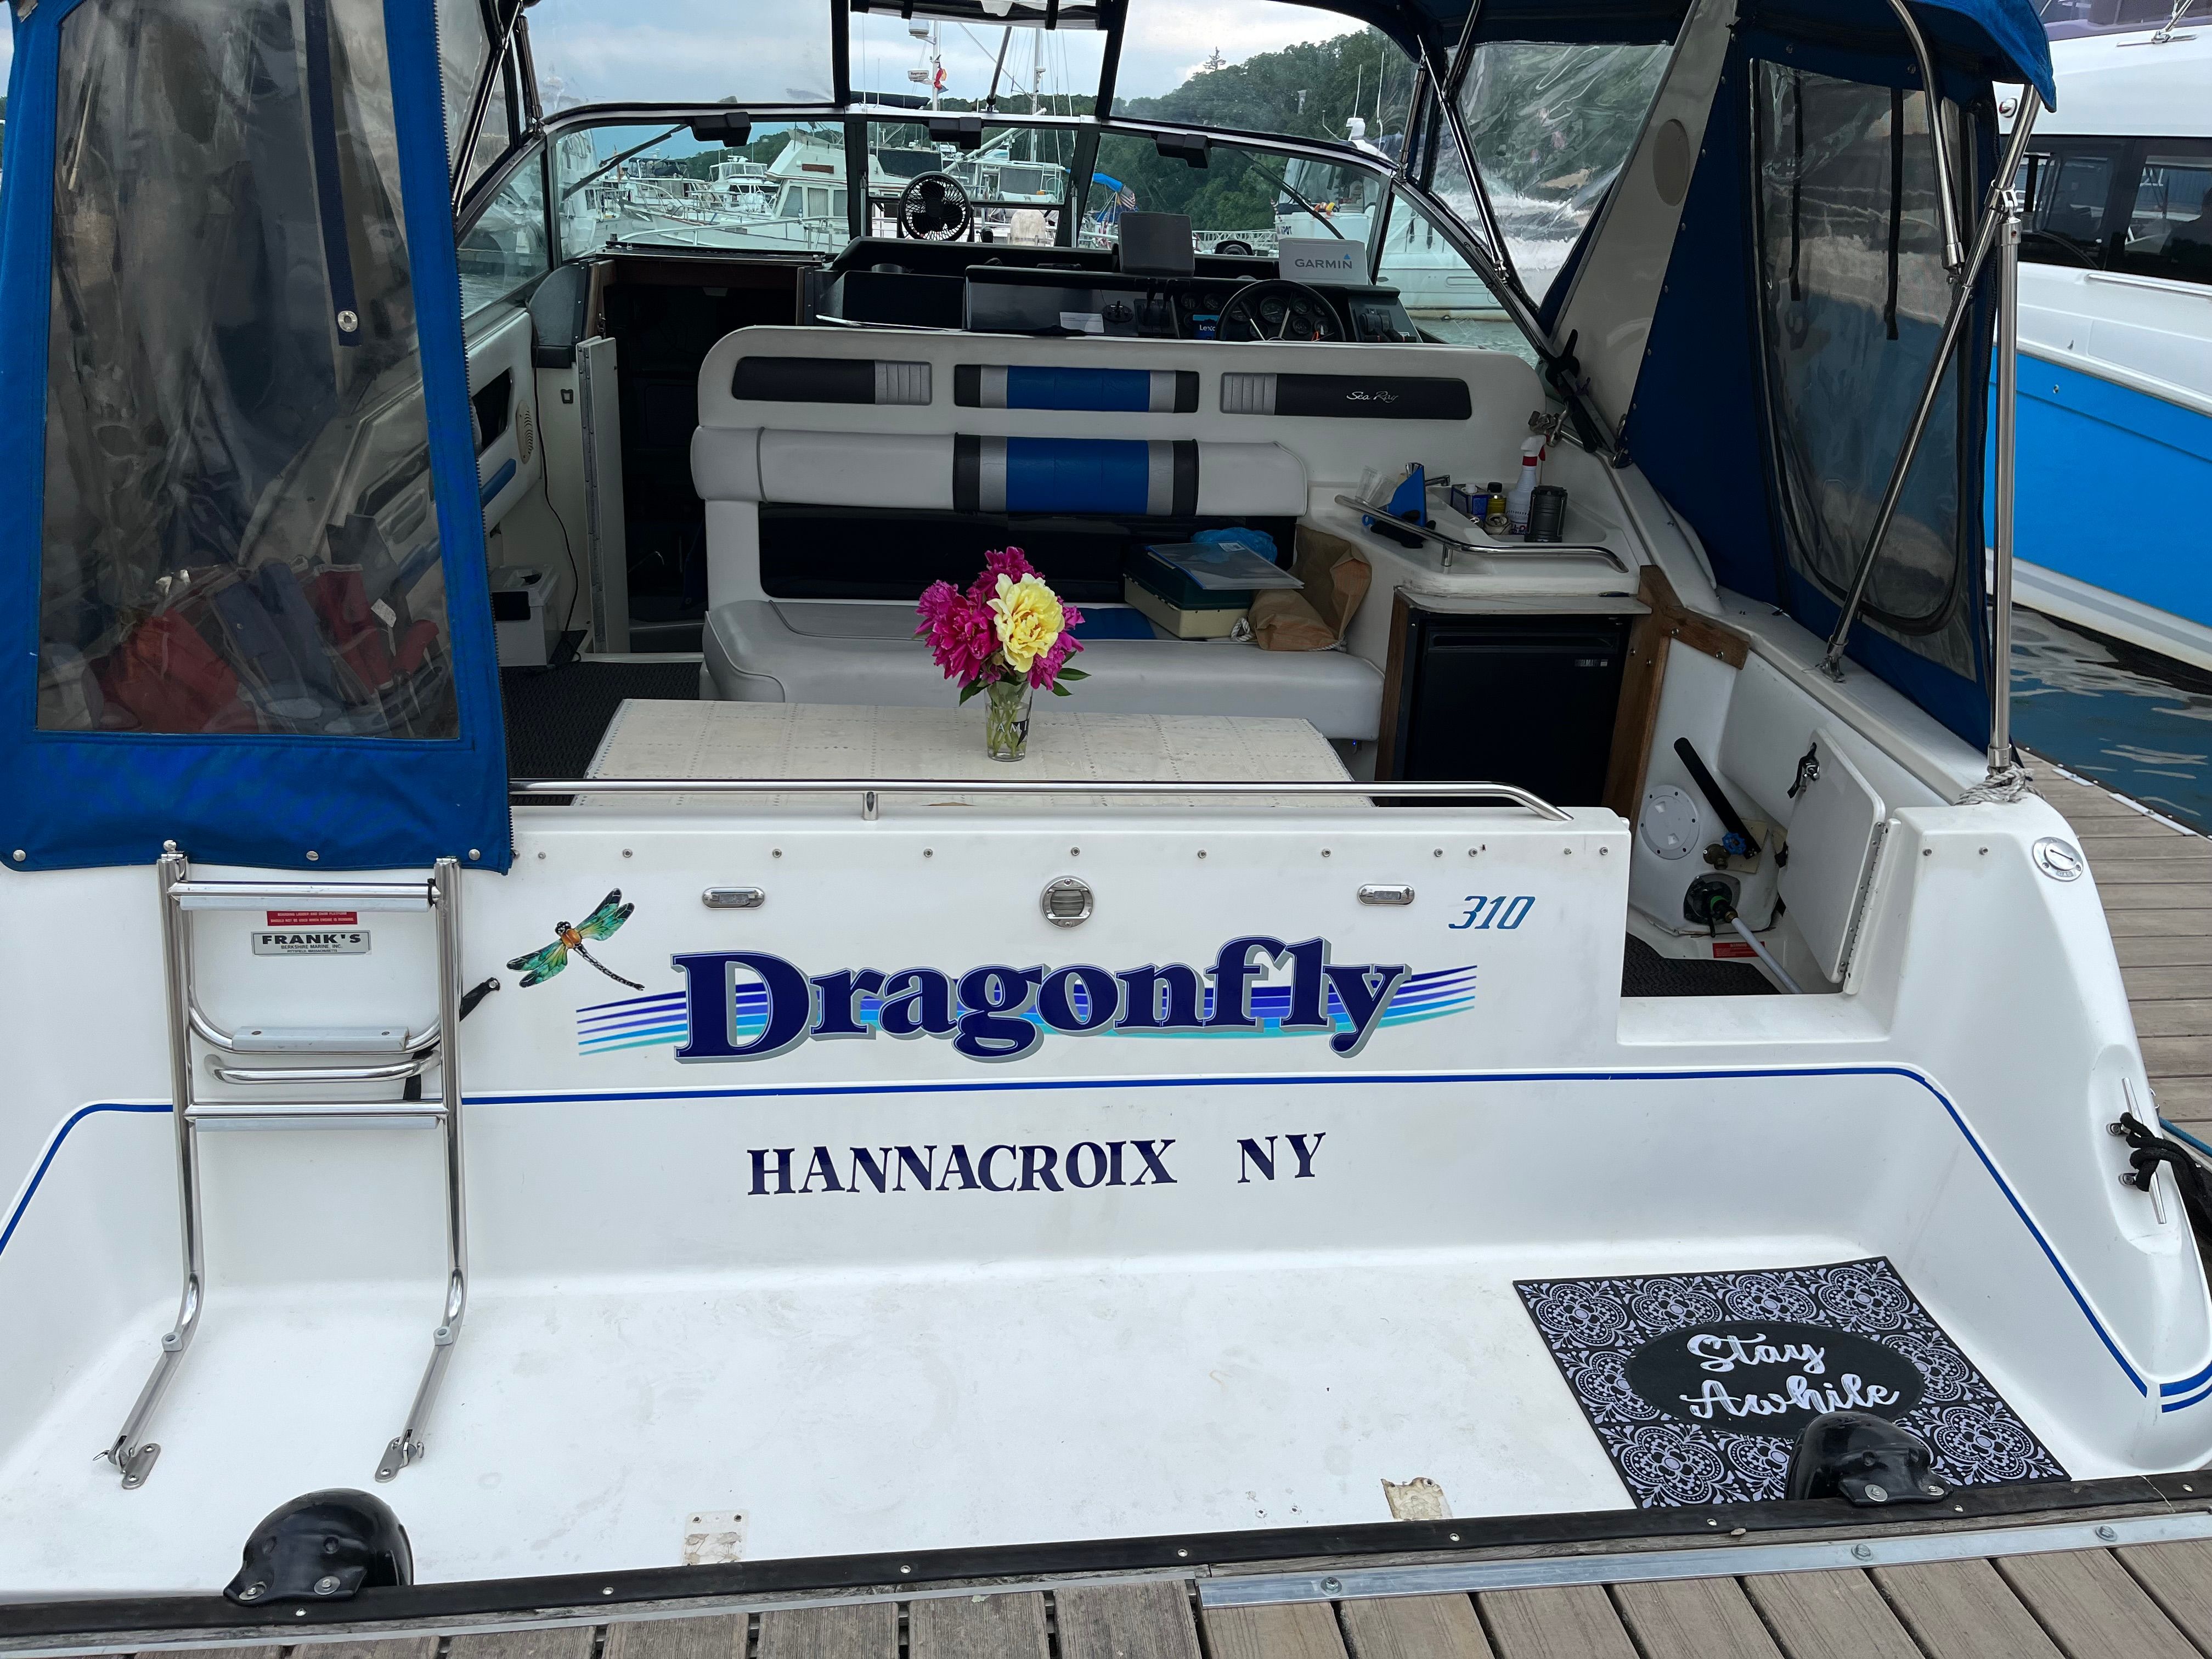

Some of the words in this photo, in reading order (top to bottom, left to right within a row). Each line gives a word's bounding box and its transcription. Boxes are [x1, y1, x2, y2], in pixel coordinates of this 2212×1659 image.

[1295, 258, 1352, 269] GARMIN
[1346, 391, 1370, 400] Sea
[1373, 391, 1399, 403] Ray
[1448, 896, 1535, 929] 310
[262, 934, 361, 944] FRANK'S
[670, 935, 1412, 1063] Dragonfly
[747, 1139, 1177, 1195] HANNACROIX
[1237, 1132, 1326, 1184] NY
[1686, 1333, 1825, 1374] Stay
[1679, 1373, 1900, 1419] Awhile
